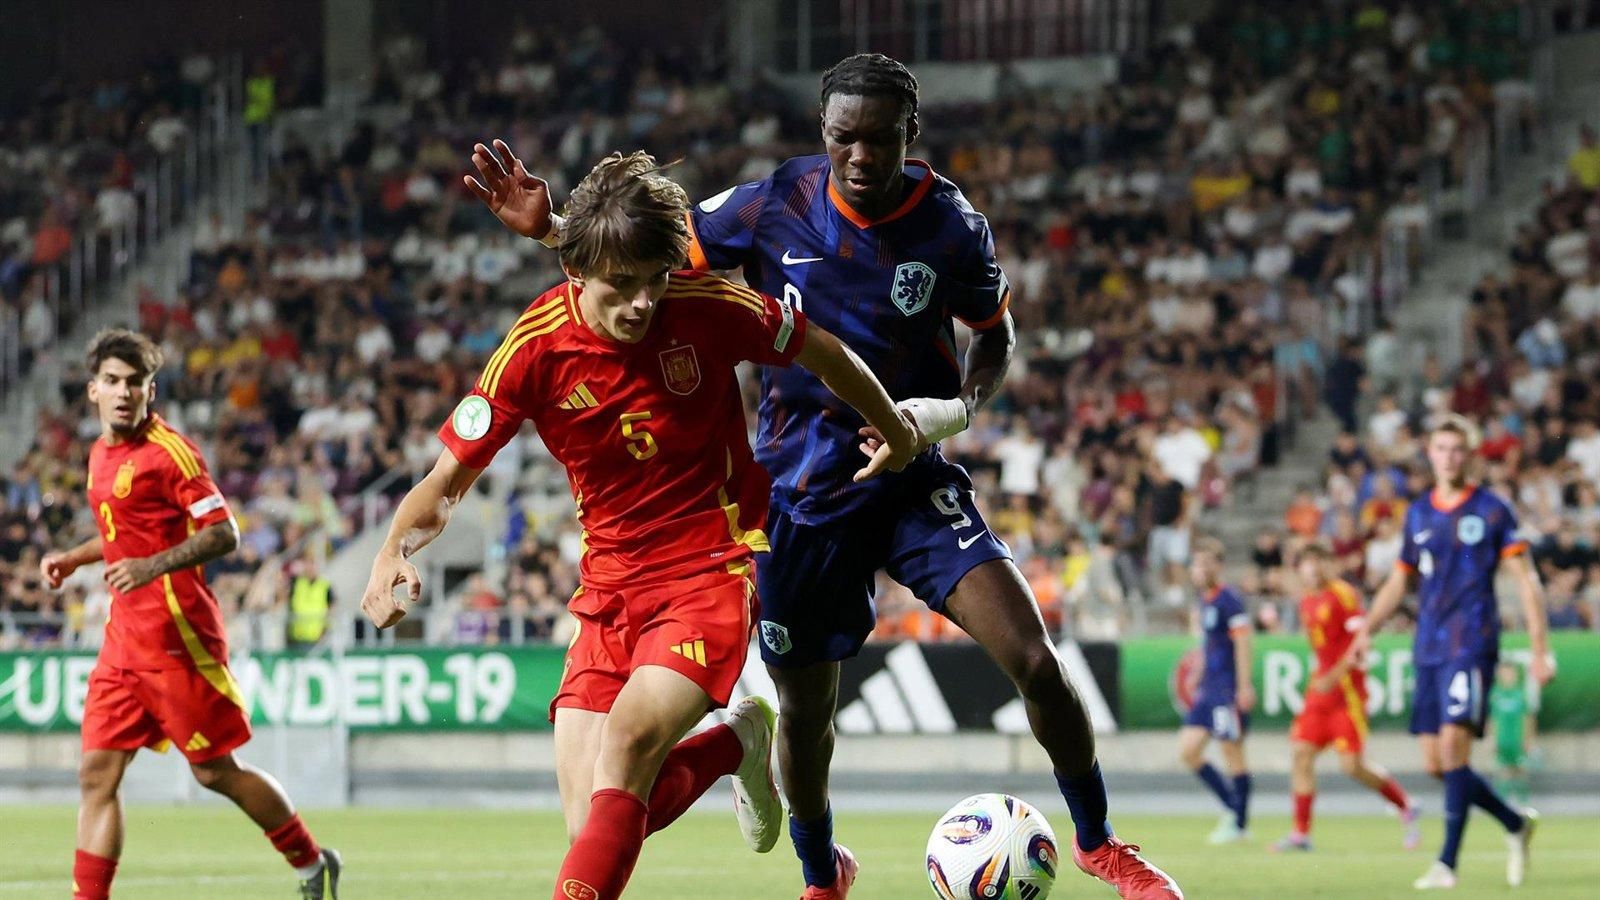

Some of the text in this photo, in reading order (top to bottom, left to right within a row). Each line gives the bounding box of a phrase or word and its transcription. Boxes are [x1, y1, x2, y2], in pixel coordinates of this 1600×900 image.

[620, 411, 658, 460] 5
[100, 501, 116, 542] 3
[931, 487, 972, 531] 9
[13, 651, 517, 726] UE NDER-19
[1448, 670, 1470, 703] 4
